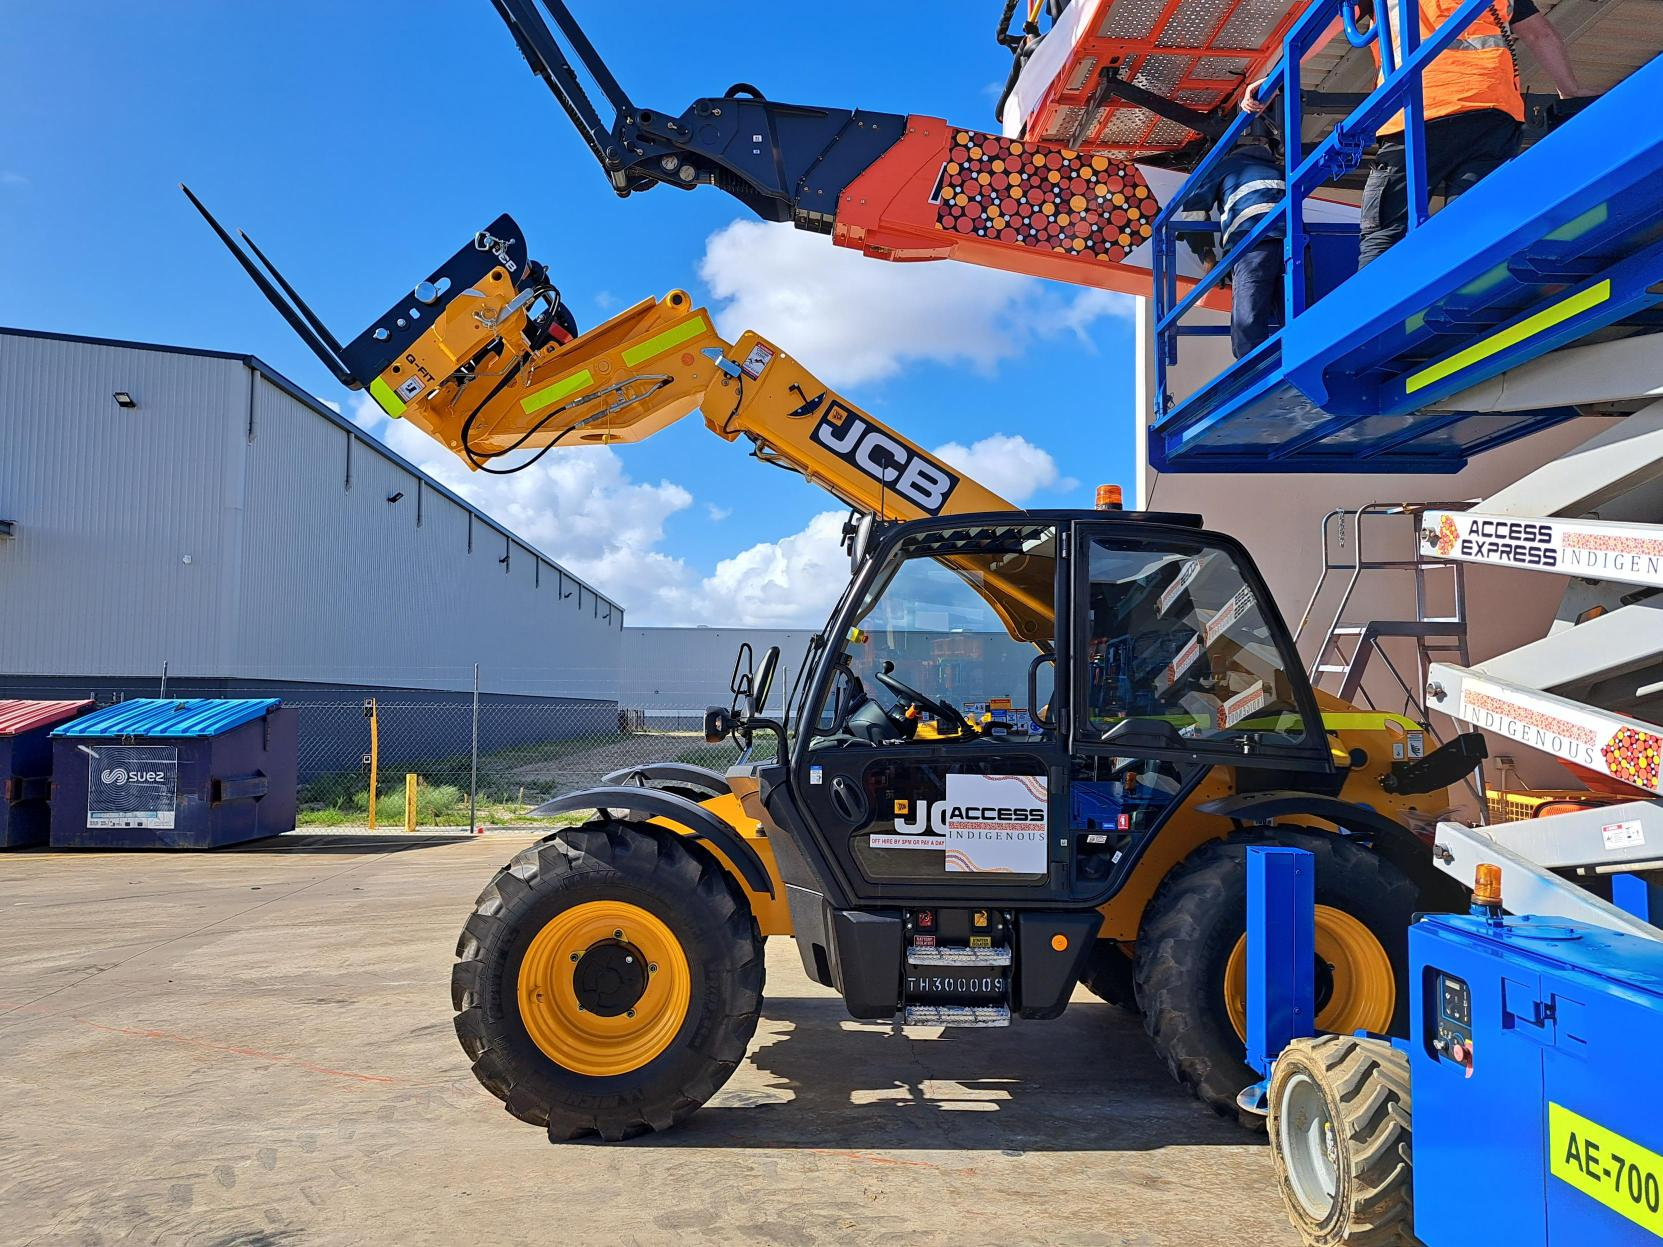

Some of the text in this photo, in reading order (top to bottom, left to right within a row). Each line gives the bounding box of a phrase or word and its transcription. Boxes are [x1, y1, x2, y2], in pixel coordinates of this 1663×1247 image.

[405, 354, 436, 382] Q-FIT
[818, 419, 951, 510] JCB
[1468, 519, 1553, 544] ACCESS
[1461, 539, 1558, 567] EXPRESS
[1463, 704, 1594, 765] INDIGENOUS
[949, 806, 1045, 822] ACCESS
[949, 830, 1045, 841] INDIGENOUS
[907, 977, 1003, 992] TH300009
[1564, 1131, 1660, 1214] AE-700
